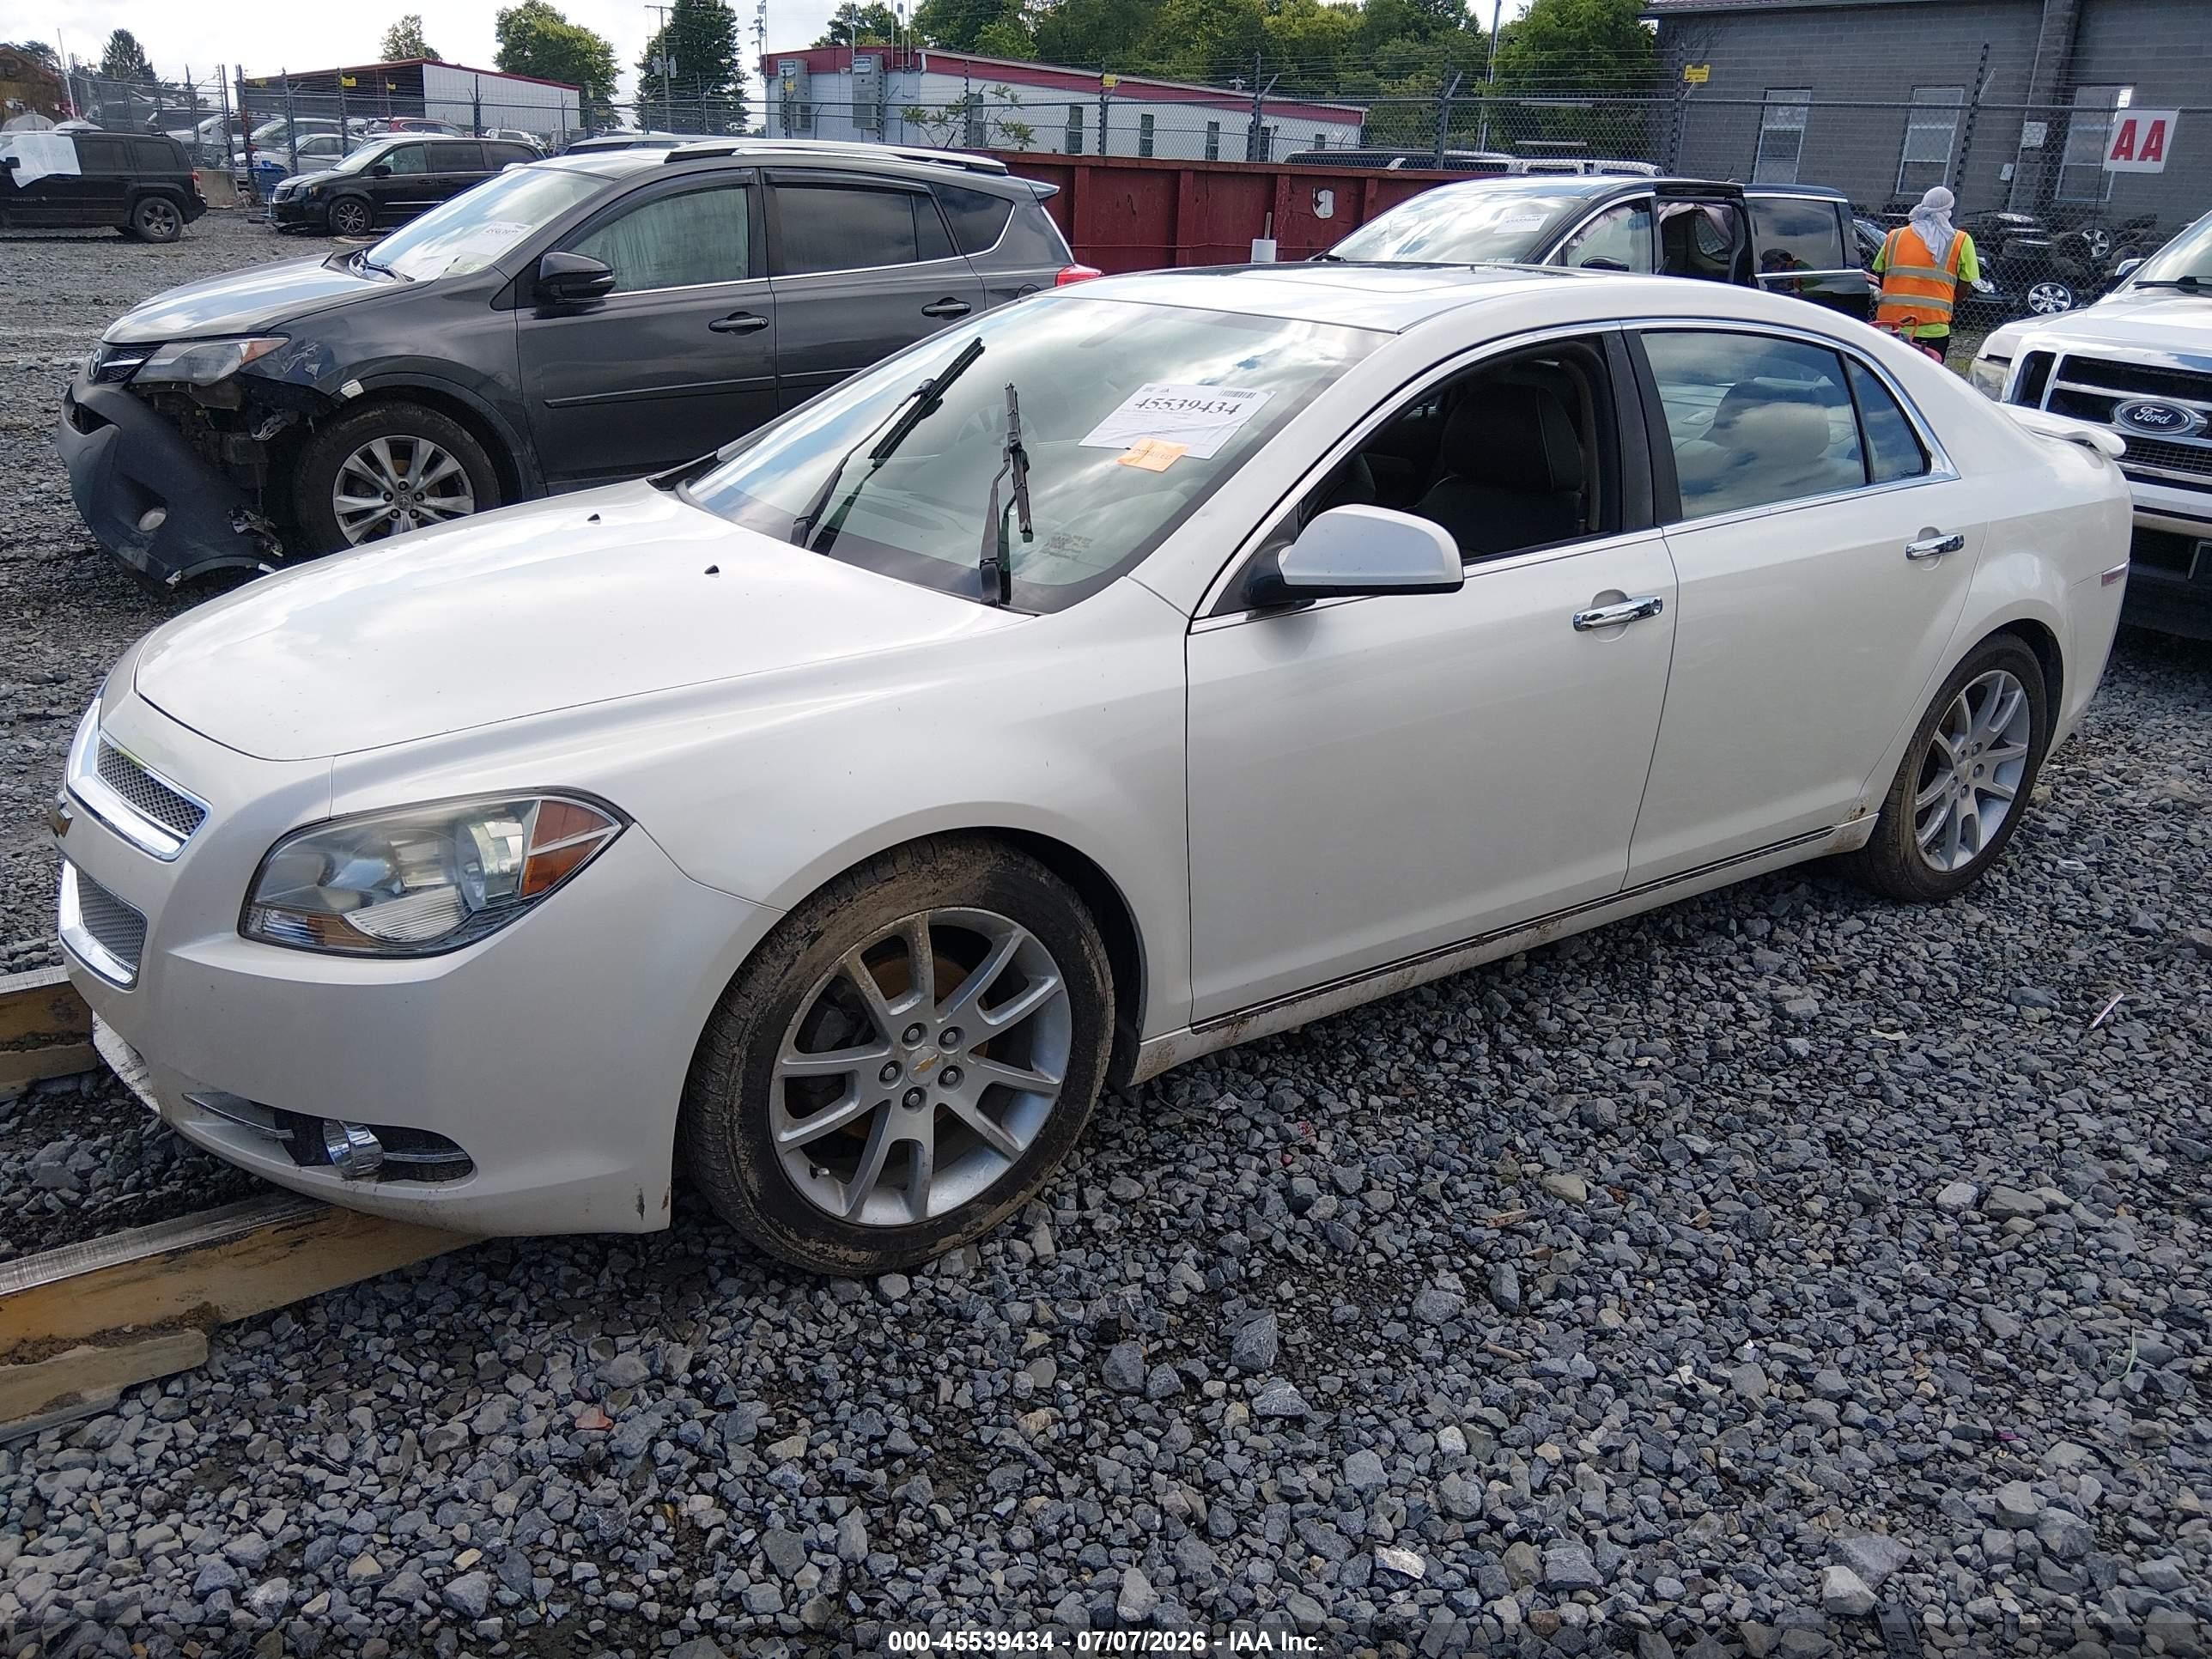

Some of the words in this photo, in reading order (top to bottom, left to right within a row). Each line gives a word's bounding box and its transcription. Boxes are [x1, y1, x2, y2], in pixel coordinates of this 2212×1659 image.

[2110, 118, 2166, 162] AA
[1134, 397, 1242, 415] 45539434
[2134, 406, 2172, 424] Ford
